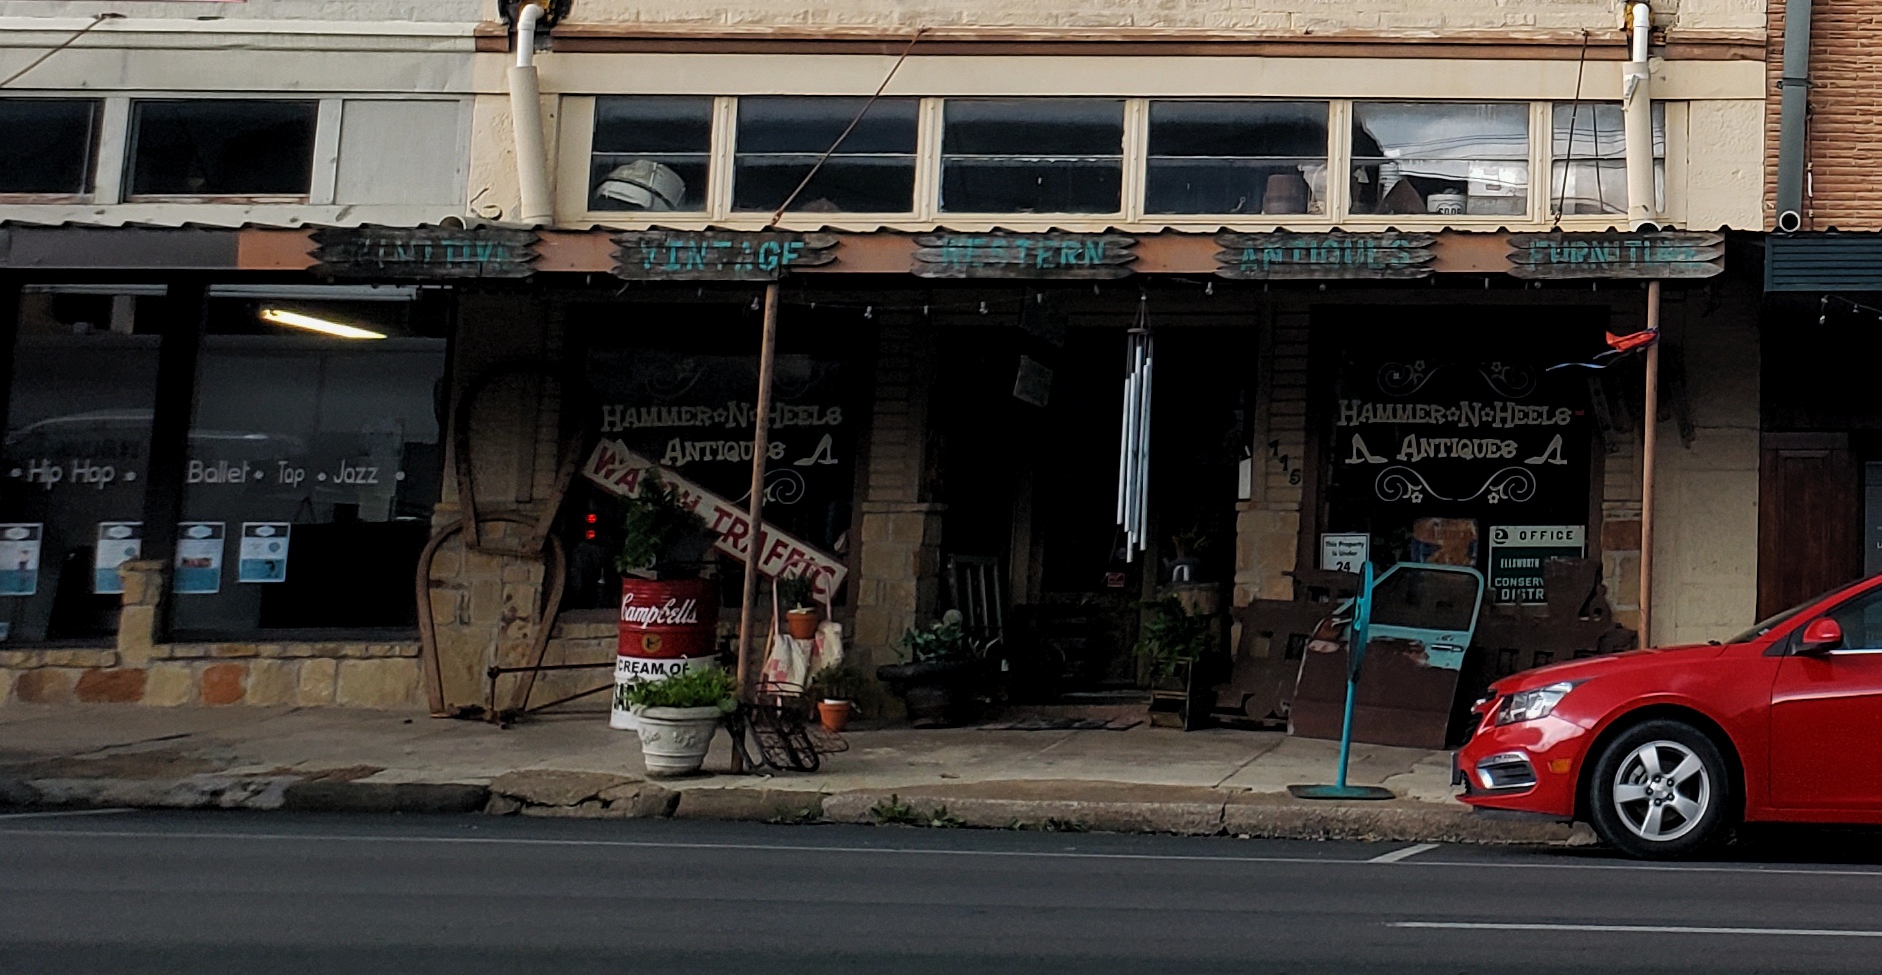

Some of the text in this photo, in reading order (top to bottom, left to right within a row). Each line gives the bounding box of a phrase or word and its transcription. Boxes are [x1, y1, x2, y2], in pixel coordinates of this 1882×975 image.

[600, 400, 844, 432] HAMMER N HEELS
[1337, 399, 1574, 429] HAMMER N HEELS
[660, 436, 787, 467] ANTIQUS
[1395, 433, 1519, 463] ANTIQUES
[28, 458, 115, 490] Hip Hop
[186, 459, 379, 487] Ballet Tap Jazz
[1519, 530, 1574, 541] OFFICE
[1500, 557, 1541, 569] ELLSWORTH
[618, 659, 692, 677] CREAM OF
